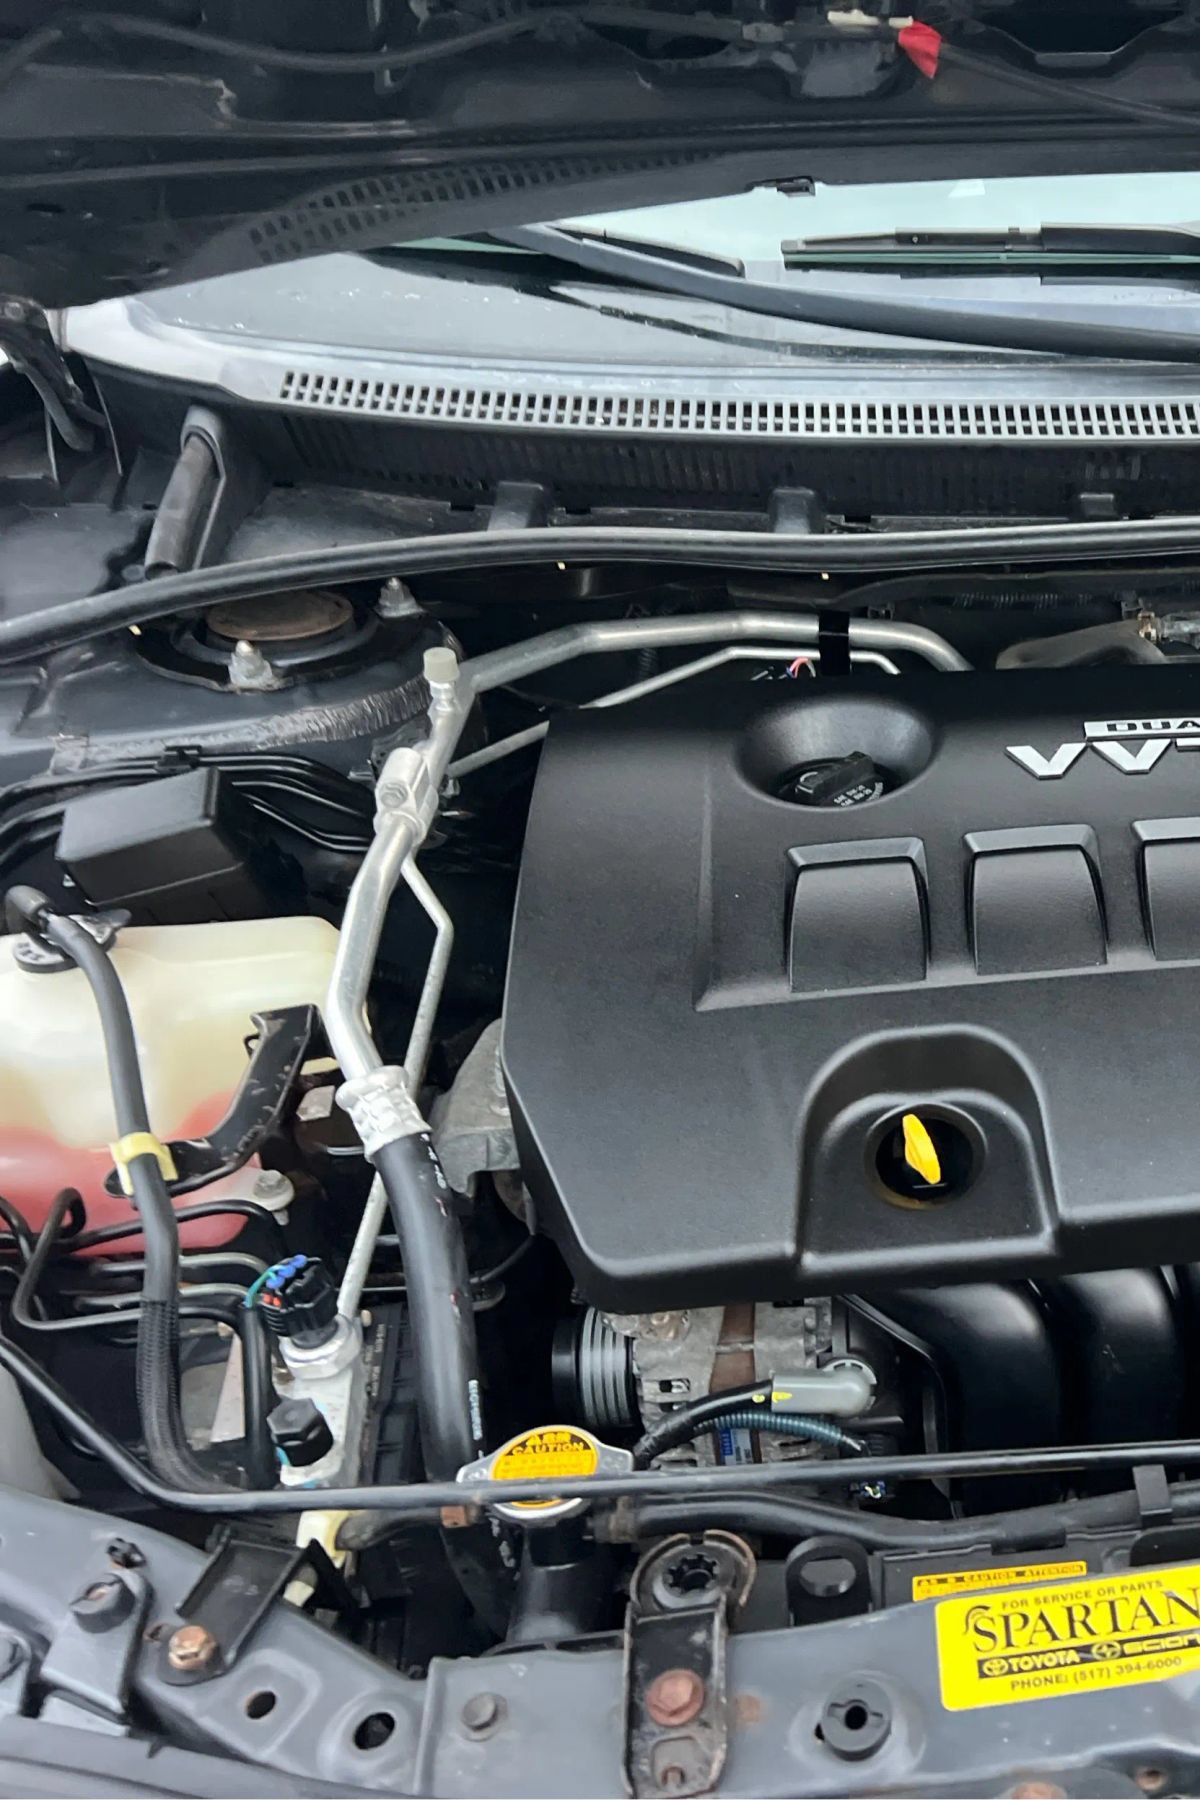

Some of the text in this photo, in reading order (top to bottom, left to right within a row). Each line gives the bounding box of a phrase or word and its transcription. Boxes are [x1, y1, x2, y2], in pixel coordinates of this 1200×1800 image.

[512, 1442, 584, 1456] CAUTION
[1001, 1579, 1164, 1610] FOR SERVICE OR PARTS
[1008, 1649, 1081, 1674] TOYOTA
[1010, 1655, 1183, 1692] PHONE: (517) 394-6000
